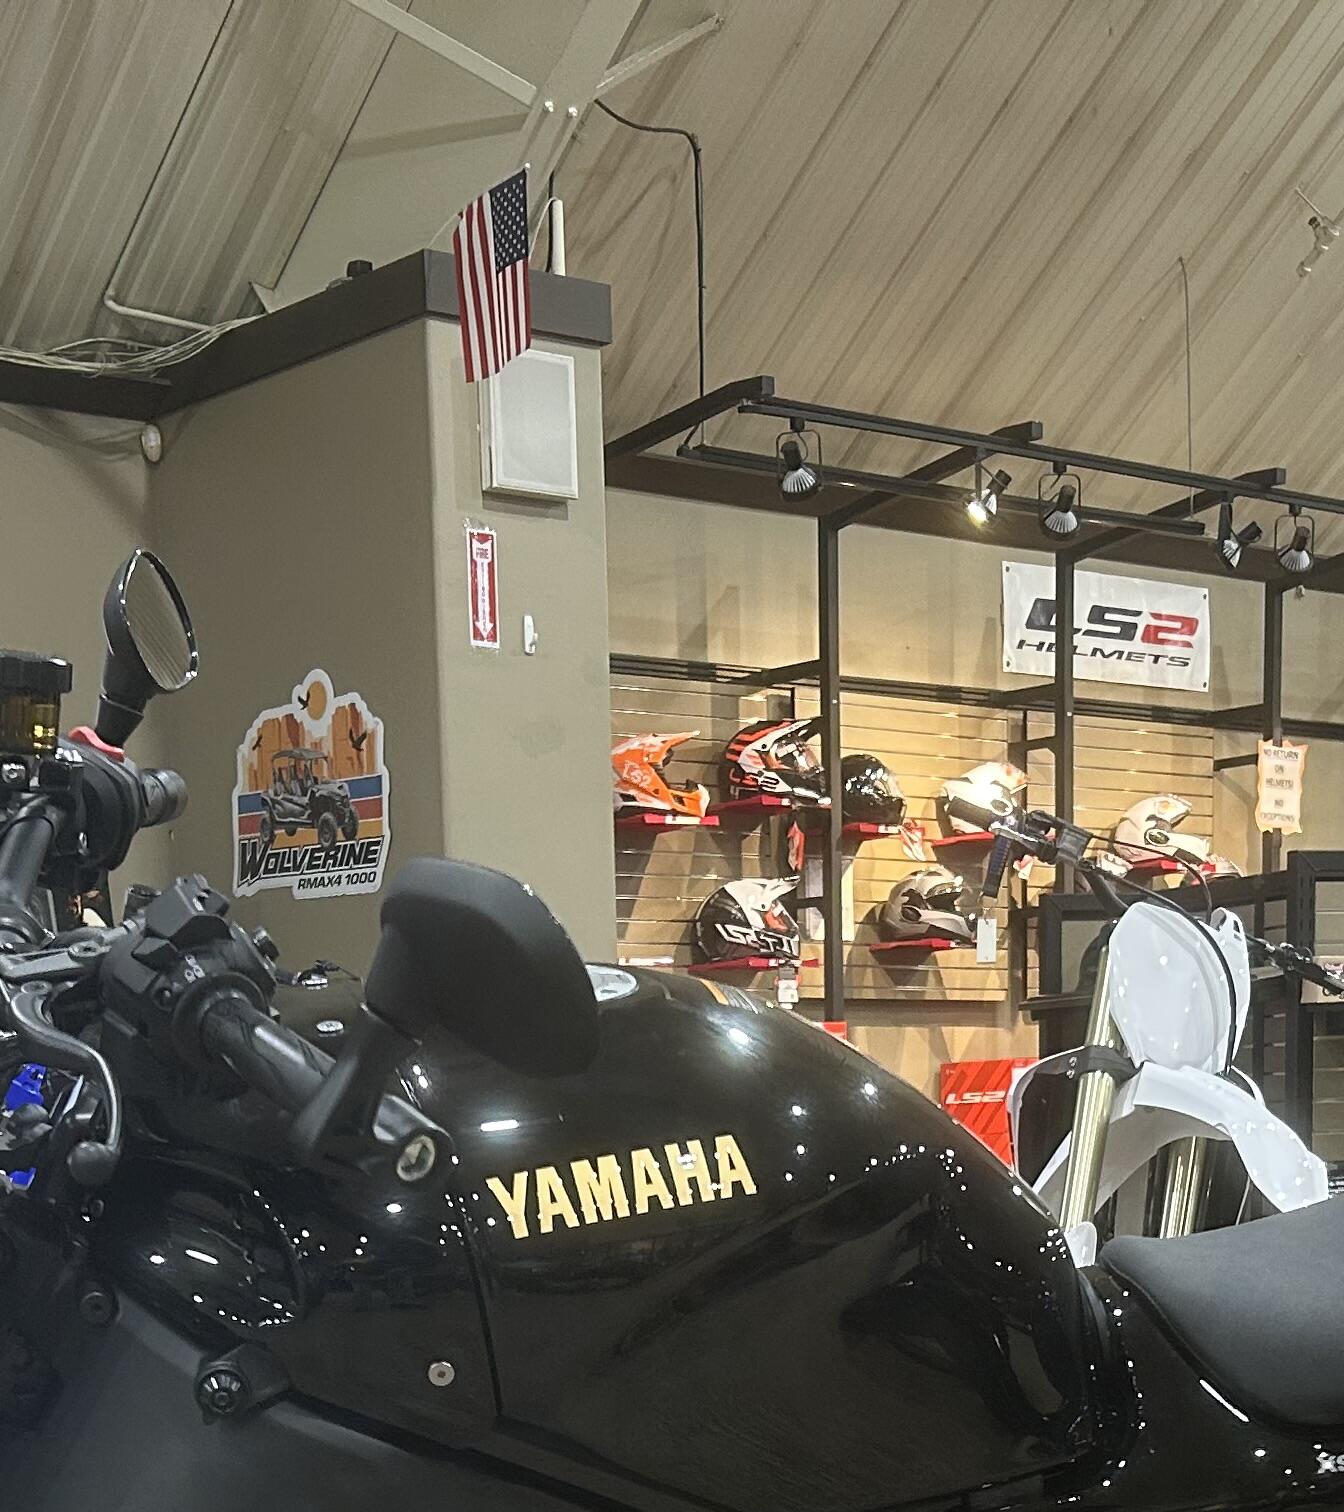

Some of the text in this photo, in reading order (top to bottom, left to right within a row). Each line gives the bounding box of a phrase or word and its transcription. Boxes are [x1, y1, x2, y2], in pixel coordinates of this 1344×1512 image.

[1025, 597, 1199, 649] LS2
[238, 836, 384, 887] WOLVERINE
[298, 871, 376, 890] RMAX4 1000
[945, 1091, 1006, 1105] LS2
[486, 1133, 758, 1240] YAMAHA
